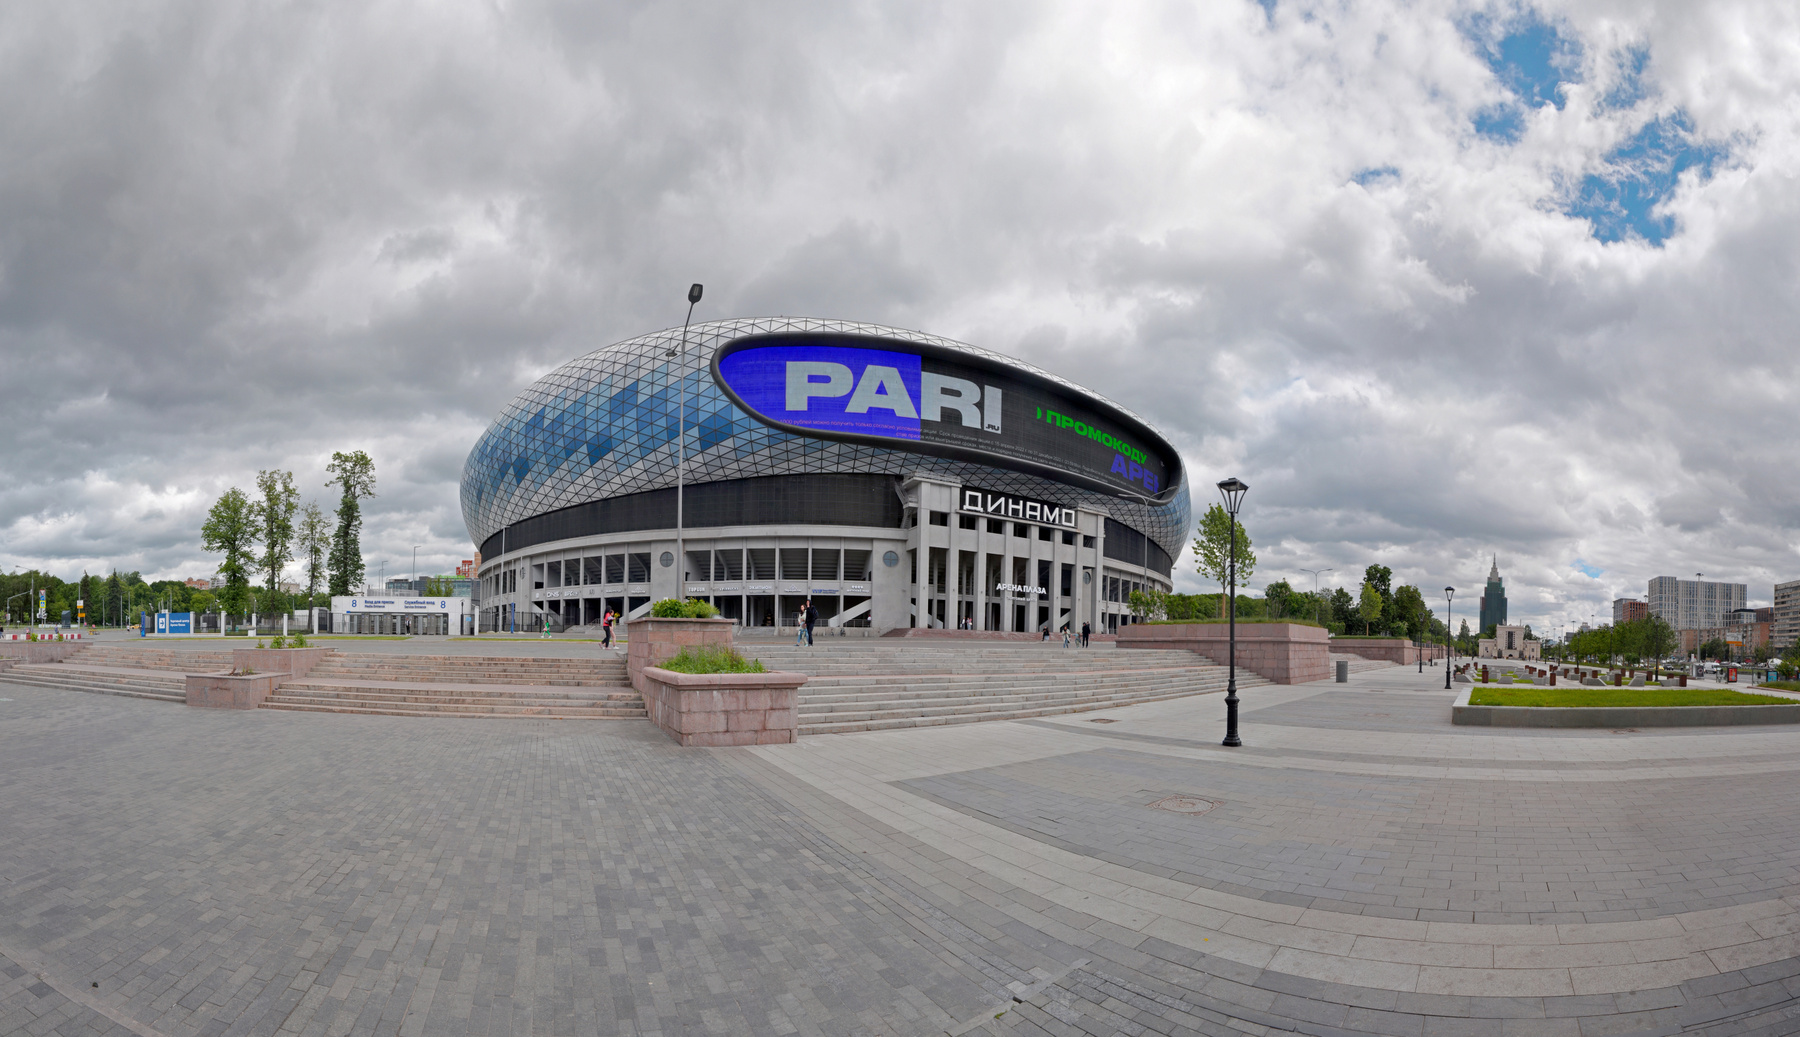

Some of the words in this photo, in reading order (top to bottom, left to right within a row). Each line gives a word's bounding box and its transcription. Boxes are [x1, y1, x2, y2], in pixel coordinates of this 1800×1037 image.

[785, 360, 1002, 434] PARI
[985, 423, 1000, 431] .RU
[1046, 409, 1147, 464] ПРОМОКОДУ
[963, 490, 1075, 527] ДИНАМО
[996, 583, 1022, 592] АРЕНА
[1023, 585, 1047, 594] ПЛАЗА
[440, 600, 446, 609] 8
